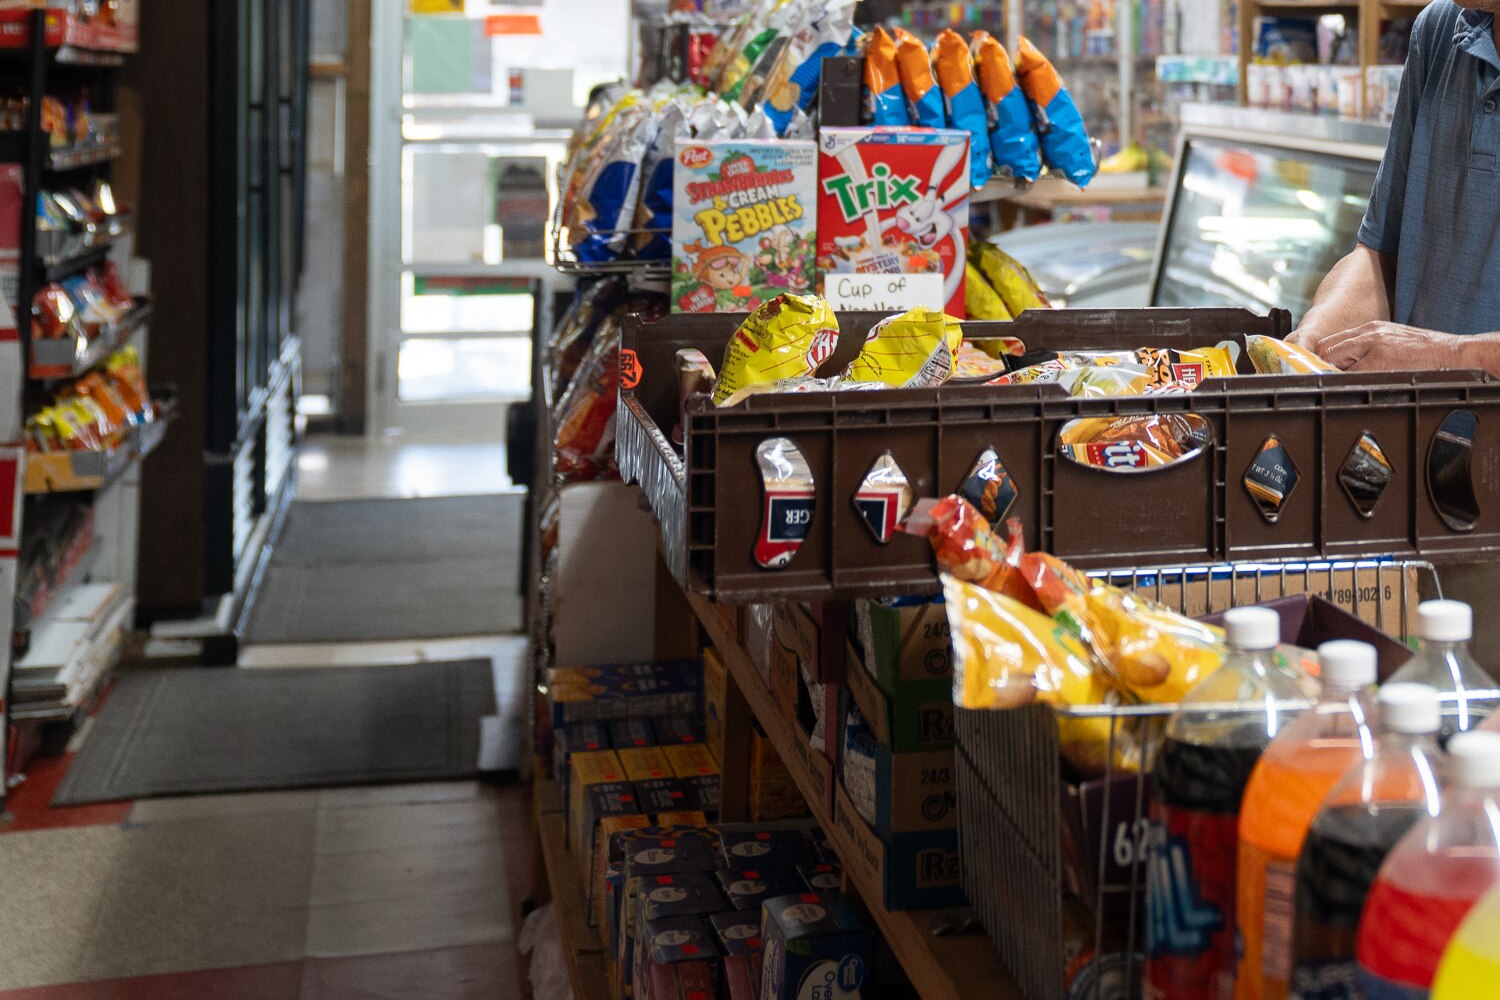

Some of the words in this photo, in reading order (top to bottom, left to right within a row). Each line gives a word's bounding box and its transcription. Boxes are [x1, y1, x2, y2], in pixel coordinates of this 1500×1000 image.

[684, 149, 708, 164] Post
[713, 196, 727, 212] &
[728, 185, 780, 209] CREAM
[825, 165, 920, 220] Trix
[694, 194, 803, 247] PEBBLES
[837, 278, 873, 299] Cup
[887, 277, 907, 292] of
[824, 971, 836, 1000] Ove
